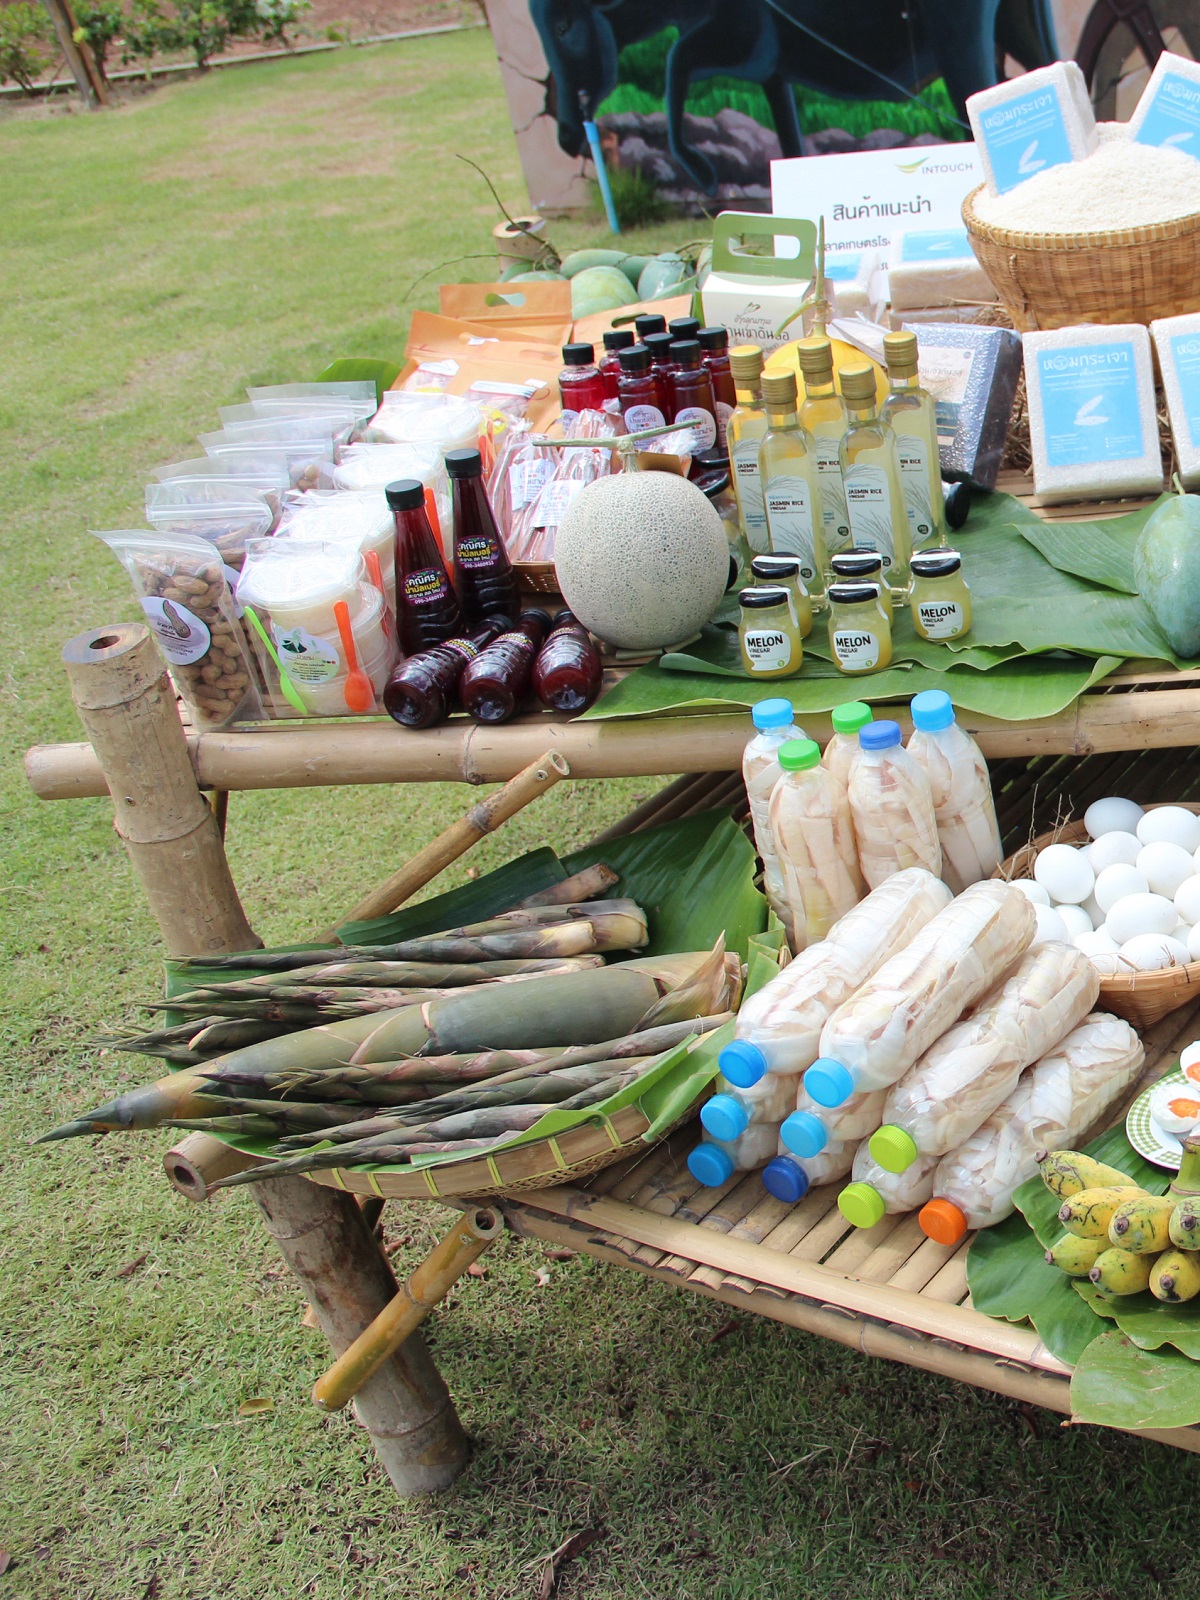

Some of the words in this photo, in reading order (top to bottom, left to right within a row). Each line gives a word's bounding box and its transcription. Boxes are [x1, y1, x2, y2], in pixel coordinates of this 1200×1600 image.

[921, 163, 973, 175] INTOUCH
[832, 195, 932, 221] สินค้าแนะนำ
[817, 236, 891, 252] ลาดเกษตรโร
[921, 605, 956, 618] MELON
[747, 635, 784, 648] MELON
[836, 635, 872, 647] MELON
